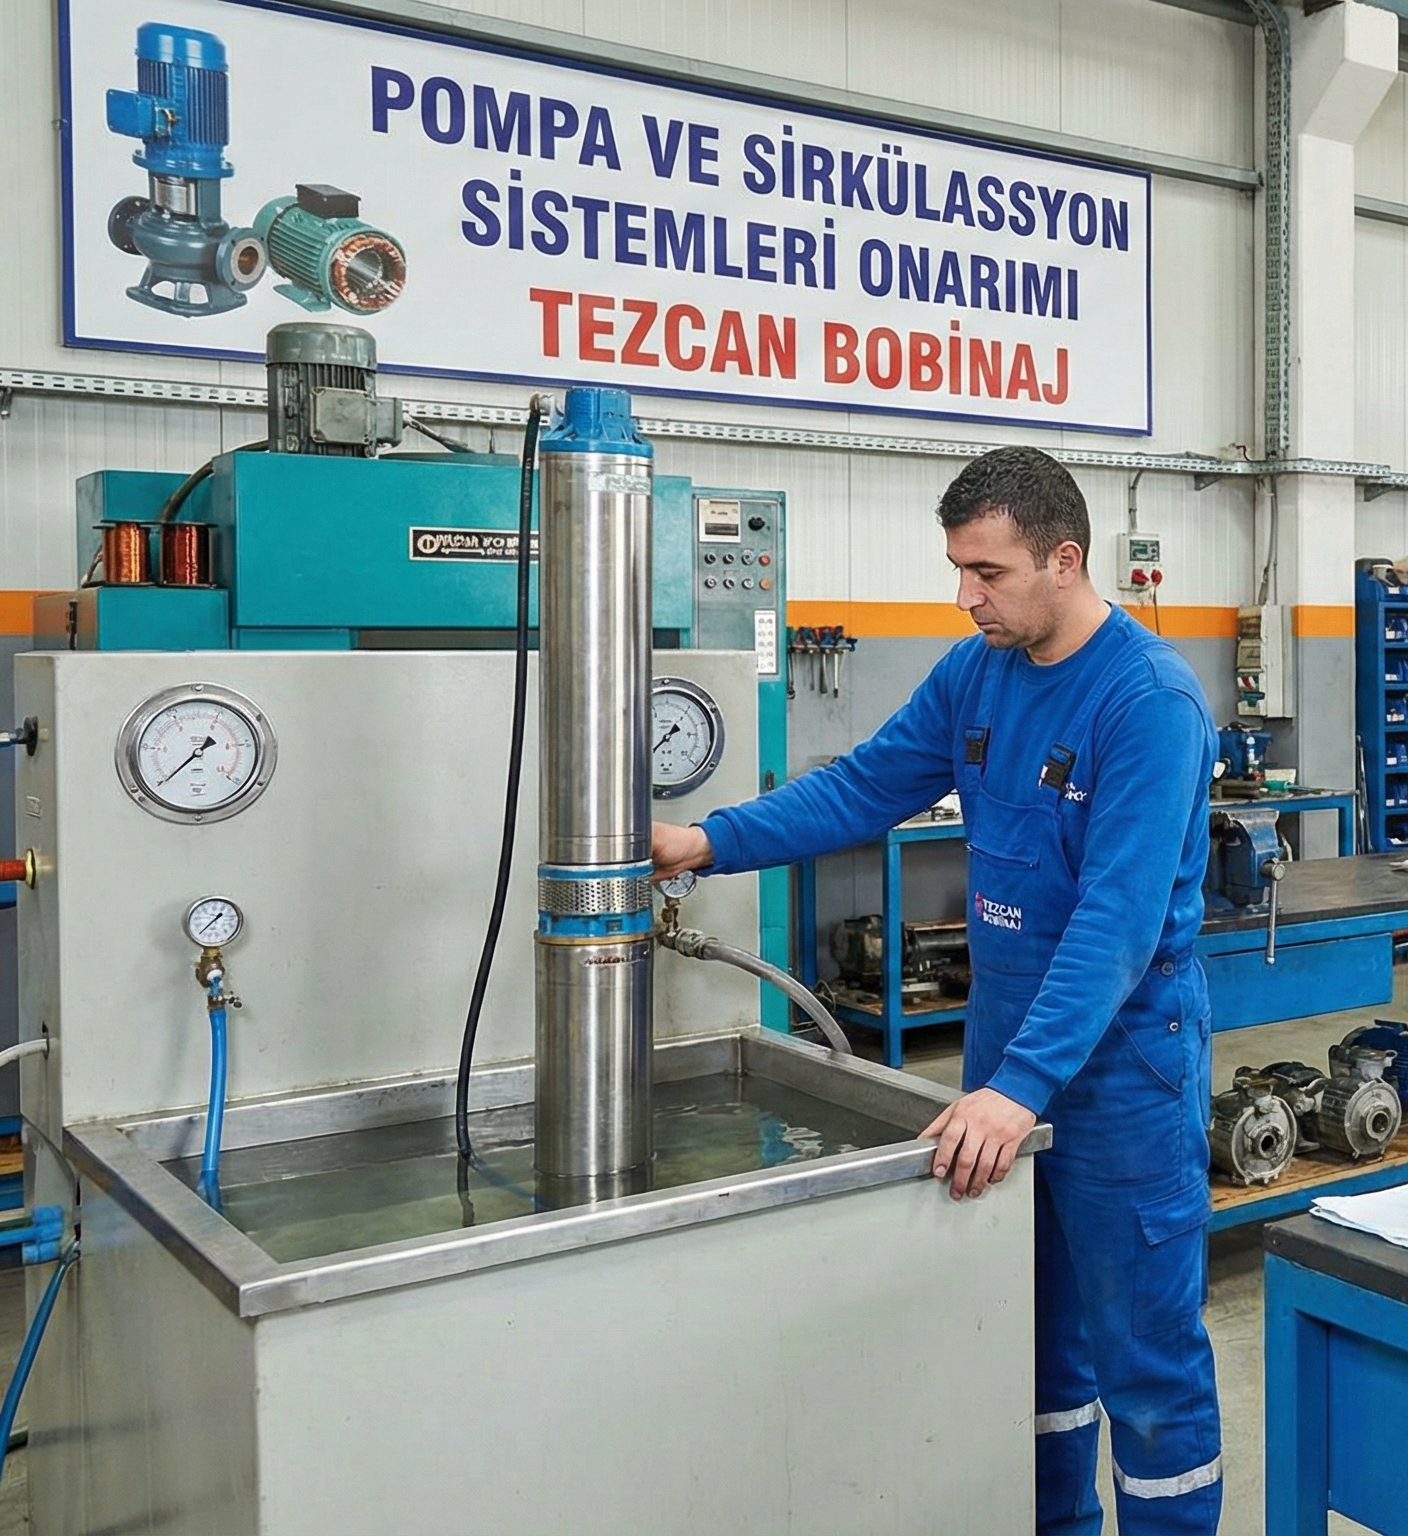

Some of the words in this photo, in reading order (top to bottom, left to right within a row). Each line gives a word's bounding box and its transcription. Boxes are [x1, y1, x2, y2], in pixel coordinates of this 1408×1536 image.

[371, 65, 621, 170] POMPA
[641, 114, 720, 187] VE
[742, 124, 1130, 251] SİRKÜLASSYON
[461, 168, 836, 290] SİSTEMLERİ
[859, 238, 1079, 320] ONARIMI
[529, 287, 797, 380] TEZCAN
[823, 319, 1069, 405] BOBİNAJ
